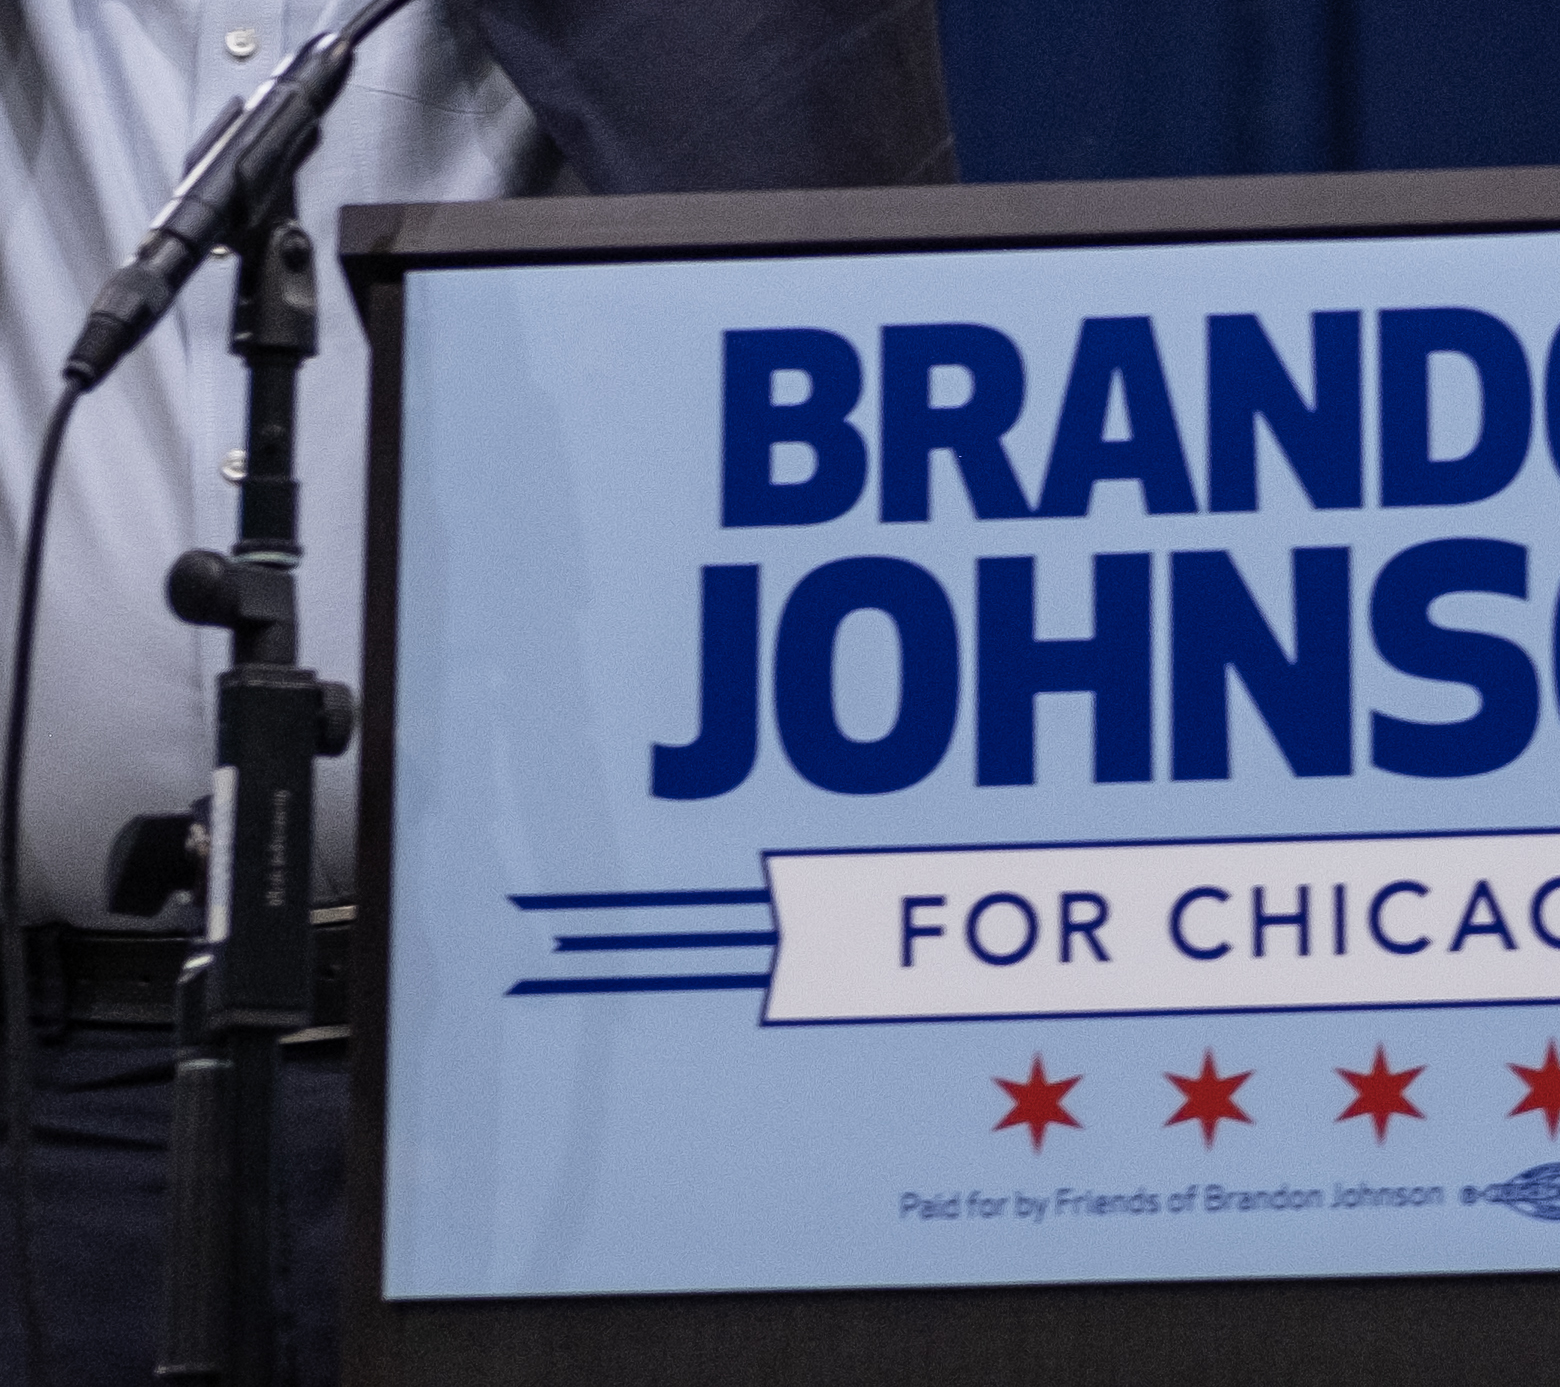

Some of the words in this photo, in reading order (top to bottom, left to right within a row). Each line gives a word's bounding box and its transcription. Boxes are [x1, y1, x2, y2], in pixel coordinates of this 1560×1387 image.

[899, 890, 1111, 969] FOR
[899, 1190, 961, 1221] Paid
[966, 1189, 1009, 1219] for
[1014, 1190, 1049, 1225] by
[1054, 1186, 1161, 1217] Friends
[1167, 1183, 1199, 1214] of
[1203, 1182, 1323, 1214] Brandon
[1329, 1181, 1444, 1210] Johnson
